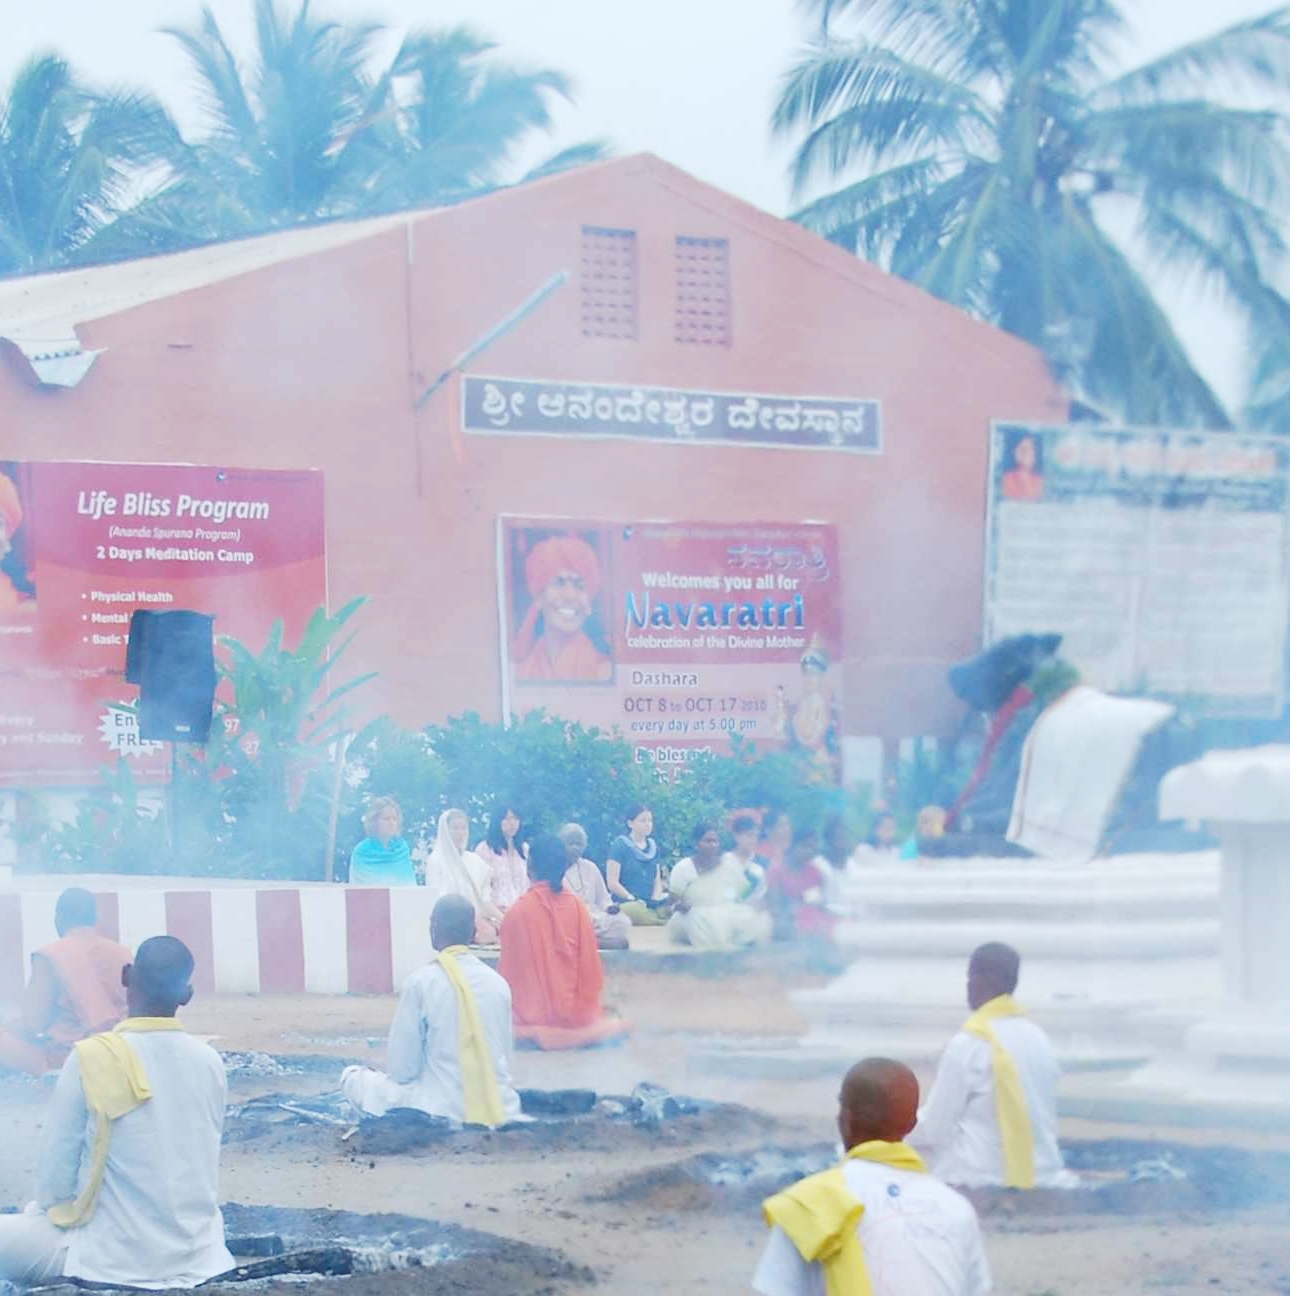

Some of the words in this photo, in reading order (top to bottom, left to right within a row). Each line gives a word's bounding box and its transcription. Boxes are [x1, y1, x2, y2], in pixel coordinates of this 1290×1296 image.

[77, 491, 117, 519] Life
[123, 493, 171, 517] Bliss
[176, 495, 269, 523] Program
[96, 546, 106, 559] 2
[109, 547, 142, 561] Days
[145, 547, 214, 561] Meditation
[217, 549, 254, 564] Camp
[641, 571, 720, 589] Welcomes
[724, 575, 751, 592] you
[756, 574, 774, 589] all
[777, 574, 800, 590] for
[91, 591, 135, 603] Physical
[138, 592, 173, 602] Health
[91, 613, 128, 623] Mental
[625, 591, 805, 636] Navaratri
[93, 634, 121, 645] Basic
[728, 636, 764, 648] Divine
[632, 670, 698, 687] Dashara
[624, 698, 653, 713] OCT
[658, 698, 667, 713] 8
[685, 698, 713, 713] OCT
[720, 698, 738, 712] 17
[631, 721, 665, 733] every
[668, 718, 689, 733] day
[740, 720, 757, 732] pm
[117, 734, 158, 746] FR
